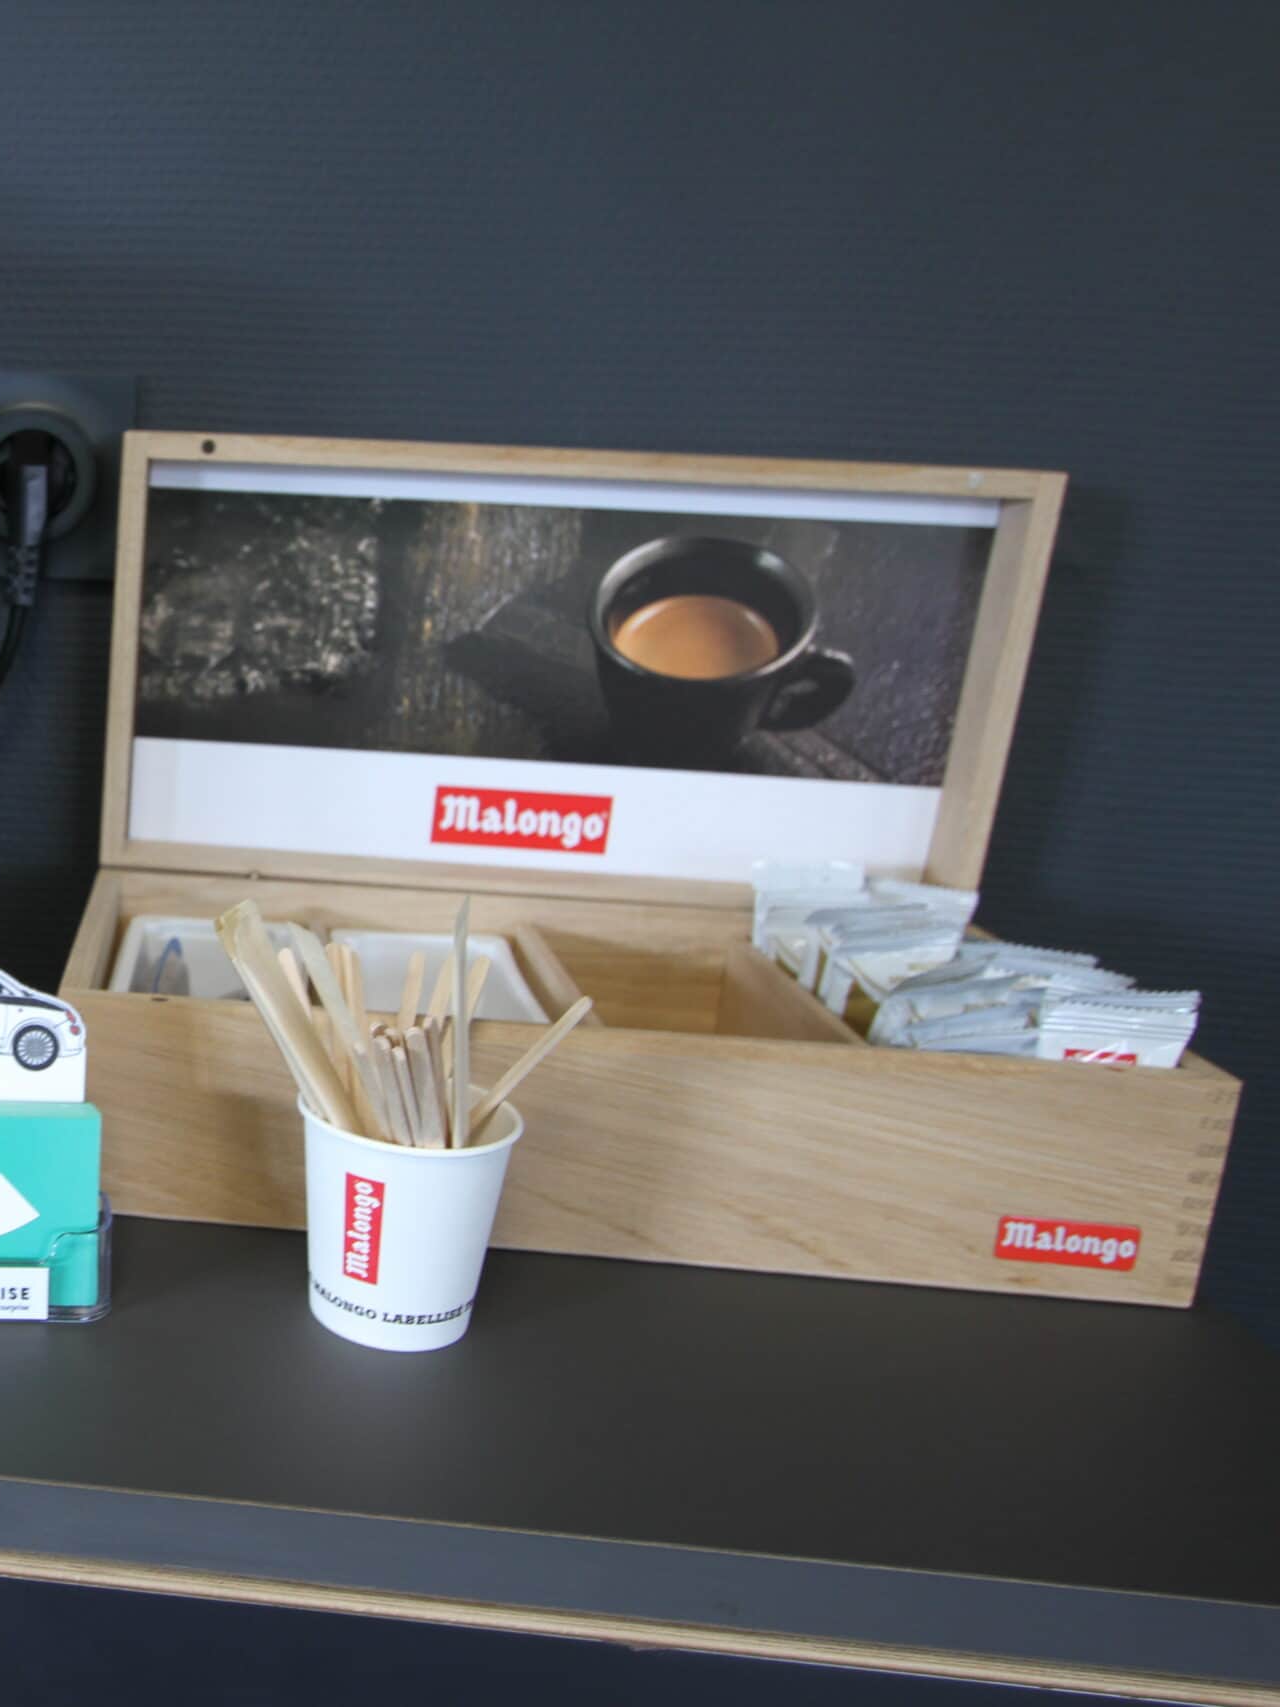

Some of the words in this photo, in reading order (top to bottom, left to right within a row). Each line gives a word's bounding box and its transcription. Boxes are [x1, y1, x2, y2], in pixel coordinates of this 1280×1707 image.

[438, 794, 606, 849] Malongo
[345, 1181, 381, 1278] Malongo
[1001, 1220, 1137, 1265] Malongo
